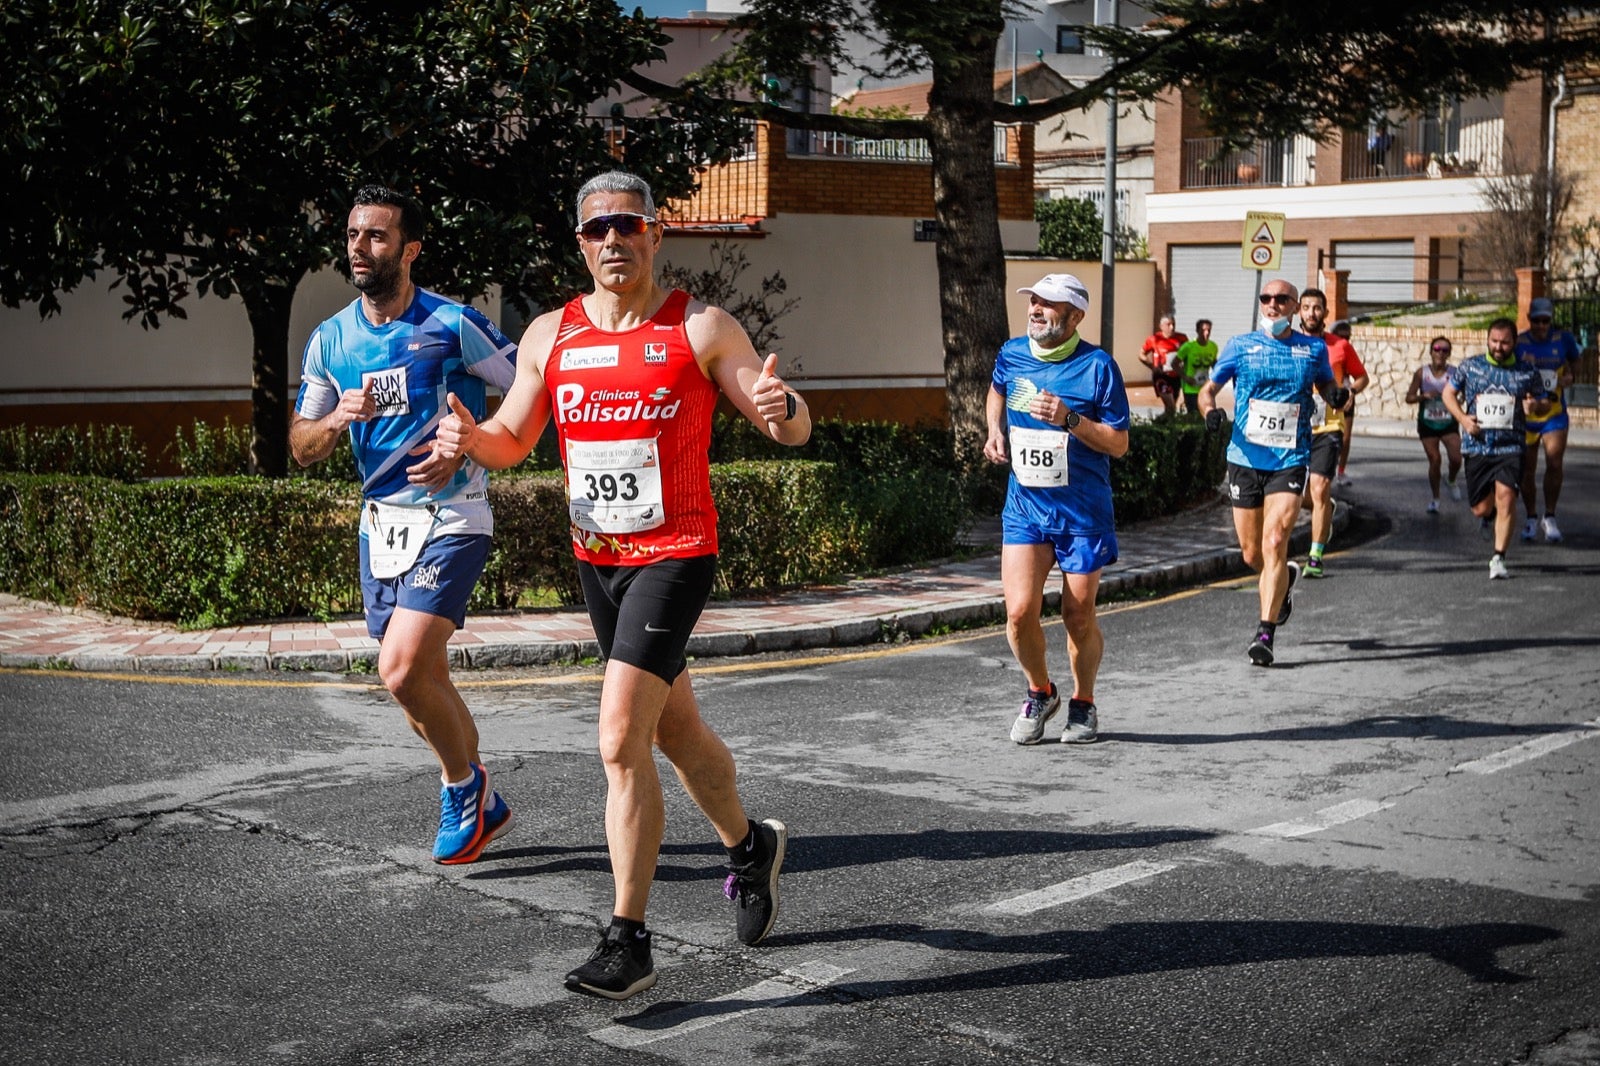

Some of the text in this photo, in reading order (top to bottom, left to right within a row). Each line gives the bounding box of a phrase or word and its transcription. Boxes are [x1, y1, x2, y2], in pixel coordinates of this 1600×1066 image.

[1255, 251, 1268, 260] 20
[646, 344, 651, 355] I
[370, 374, 400, 392] RUN
[556, 383, 681, 424] Polisalud
[590, 389, 640, 402] Clínicas
[1259, 415, 1286, 431] 751
[1020, 448, 1054, 467] 158
[585, 473, 639, 501] 393
[386, 526, 409, 550] 41
